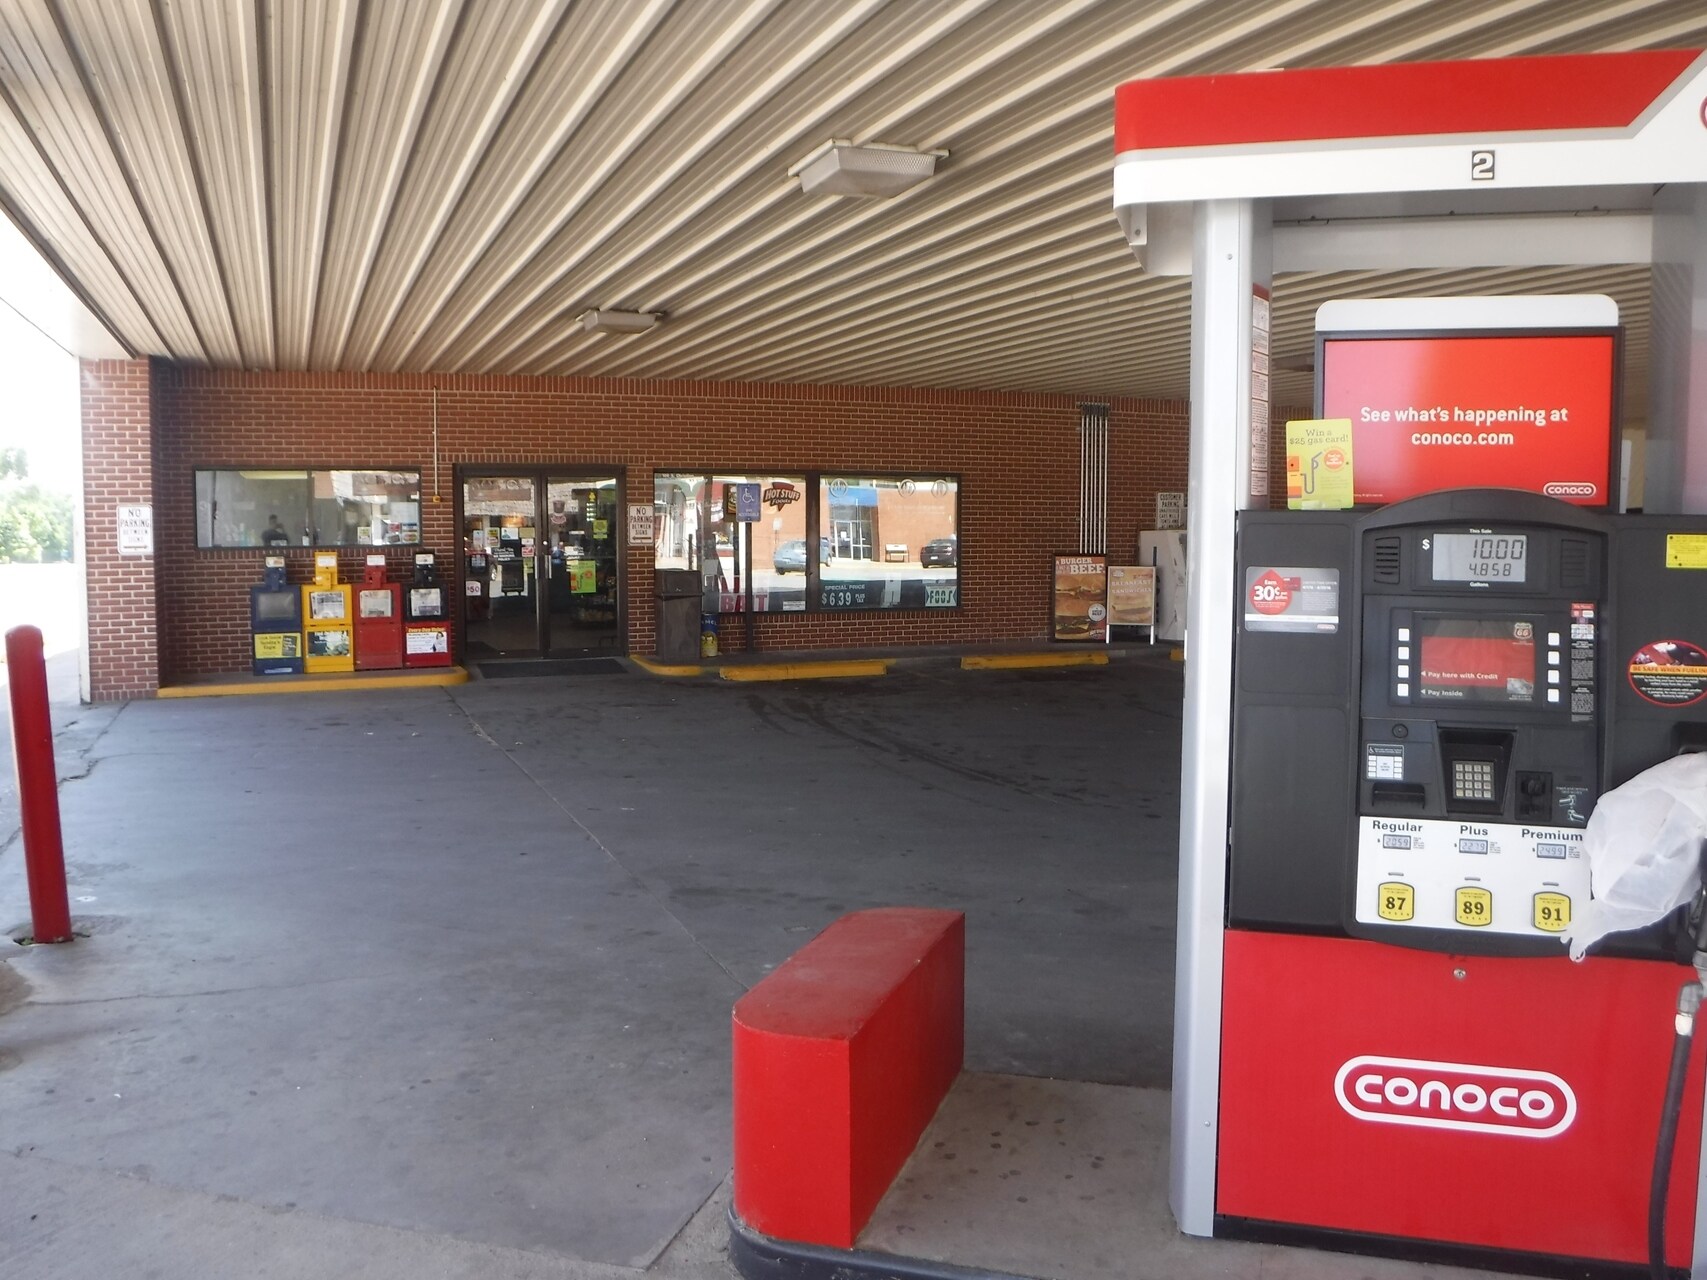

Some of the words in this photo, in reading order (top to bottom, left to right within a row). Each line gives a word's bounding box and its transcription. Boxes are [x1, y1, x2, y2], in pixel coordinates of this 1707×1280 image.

[1473, 152, 1494, 179] 2
[1360, 407, 1391, 423] See
[1394, 406, 1450, 423] what's
[1453, 406, 1546, 427] happening
[1550, 407, 1568, 422] at
[1306, 429, 1325, 437] Win
[1411, 431, 1514, 446] conoco.com
[1307, 438, 1324, 446] gas
[1325, 434, 1349, 444] card!
[765, 489, 780, 500] HOT
[781, 489, 800, 500] STUFF
[128, 508, 141, 518] NO
[636, 507, 647, 515] NO
[120, 519, 150, 528] PARKING
[630, 516, 653, 524] PARKING
[1422, 538, 1431, 551] $
[1472, 538, 1525, 560] 10.00
[1060, 557, 1093, 566] BURGER
[1468, 562, 1512, 577] 4.858
[1516, 628, 1529, 637] 66
[1427, 671, 1441, 680] Pay
[1442, 671, 1458, 679] here
[1459, 672, 1475, 680] with
[1476, 672, 1498, 680] Credit
[1427, 689, 1441, 697] Pay
[1372, 820, 1423, 833] Regular
[1459, 825, 1489, 837] Plus
[1521, 828, 1584, 843] Premium
[1385, 895, 1407, 911] 87
[1462, 900, 1485, 916] 89
[1541, 906, 1563, 922] 91
